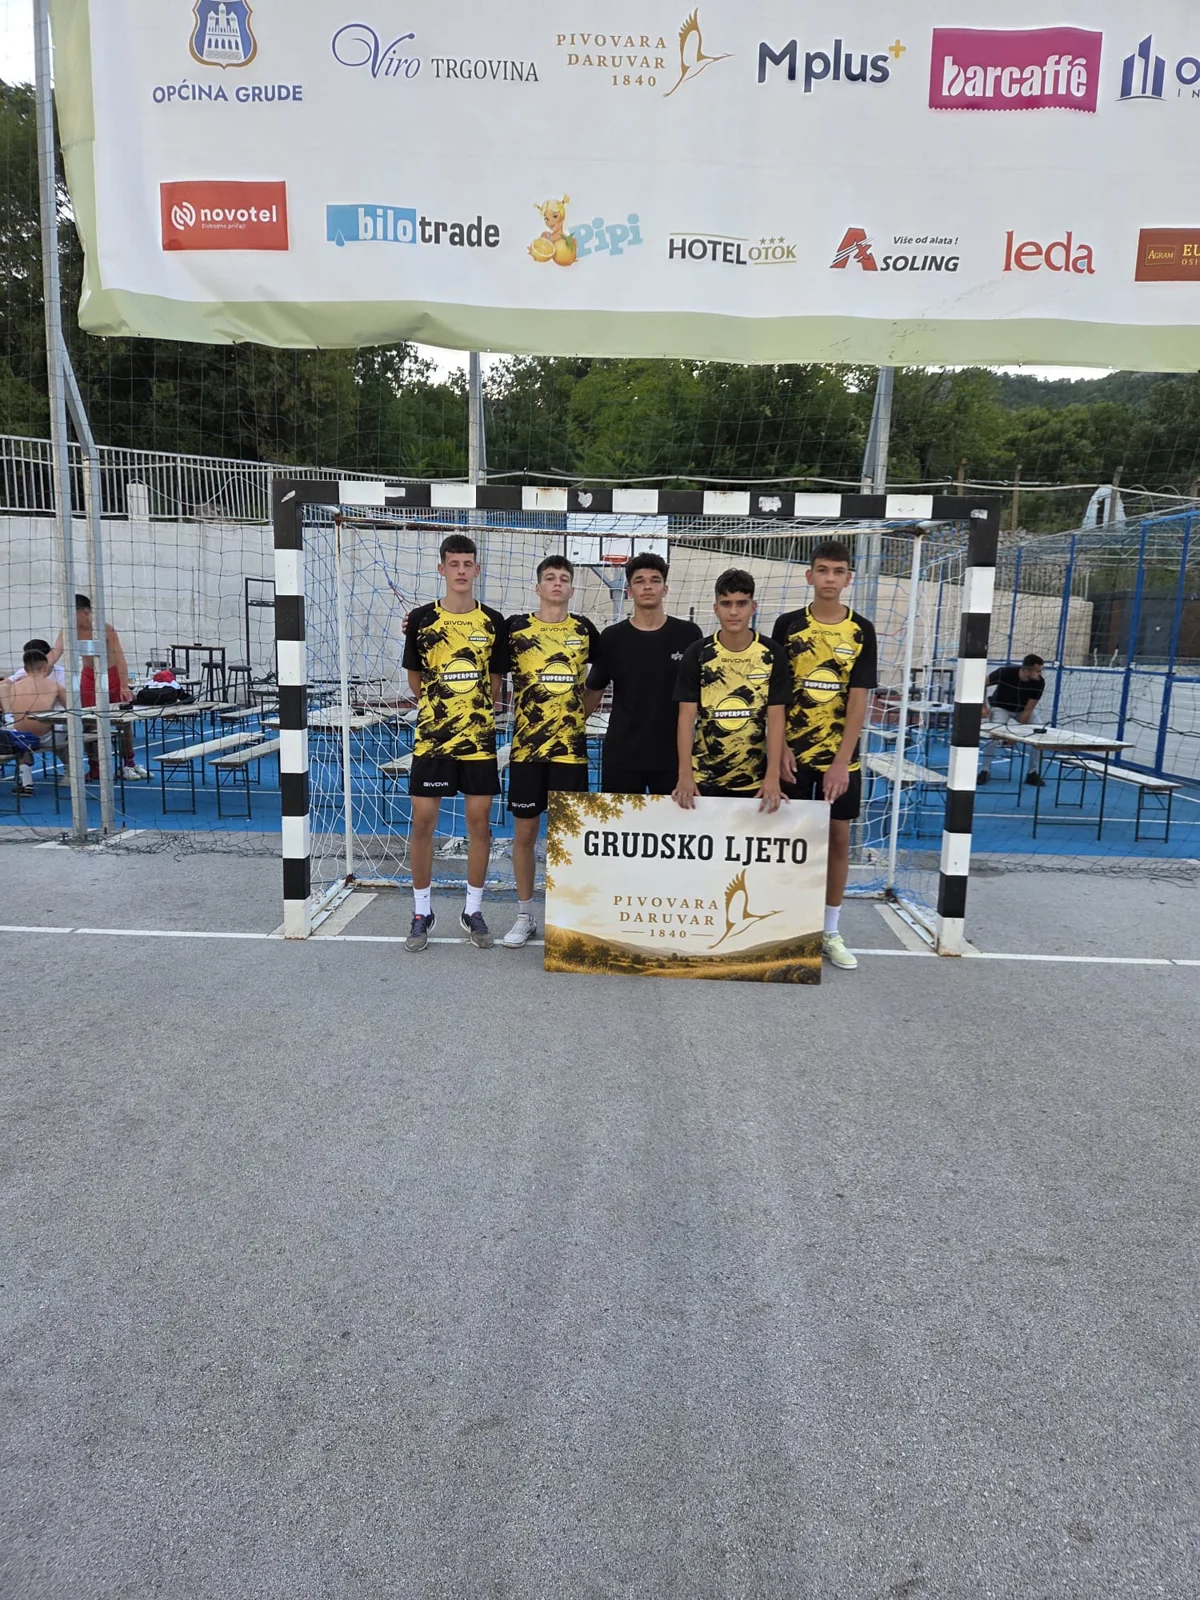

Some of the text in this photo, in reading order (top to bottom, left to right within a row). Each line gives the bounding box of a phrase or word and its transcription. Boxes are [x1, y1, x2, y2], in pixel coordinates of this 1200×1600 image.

[556, 33, 667, 49] PIVOVARA
[567, 53, 666, 69] DARUVAR
[431, 58, 539, 82] TRGOVINA
[942, 54, 1088, 98] barcaffé
[612, 75, 657, 87] 1840
[152, 79, 303, 104] OPĆINA GRUDE
[200, 205, 277, 222] novotel
[893, 236, 913, 245] Više
[915, 236, 928, 244] od
[929, 237, 953, 245] alata
[669, 238, 797, 265] HOTEL OTOK
[1003, 230, 1095, 275] leda
[880, 255, 960, 272] SOLING
[443, 672, 479, 680] SUPERPEK
[804, 680, 840, 690] SUPERPEK
[714, 710, 751, 718] SUPERPEK
[584, 830, 808, 866] GRUDSKO LJETO
[613, 895, 719, 910] PIVOVARA
[619, 911, 715, 926] DARUVAR
[649, 929, 687, 939] 1840
